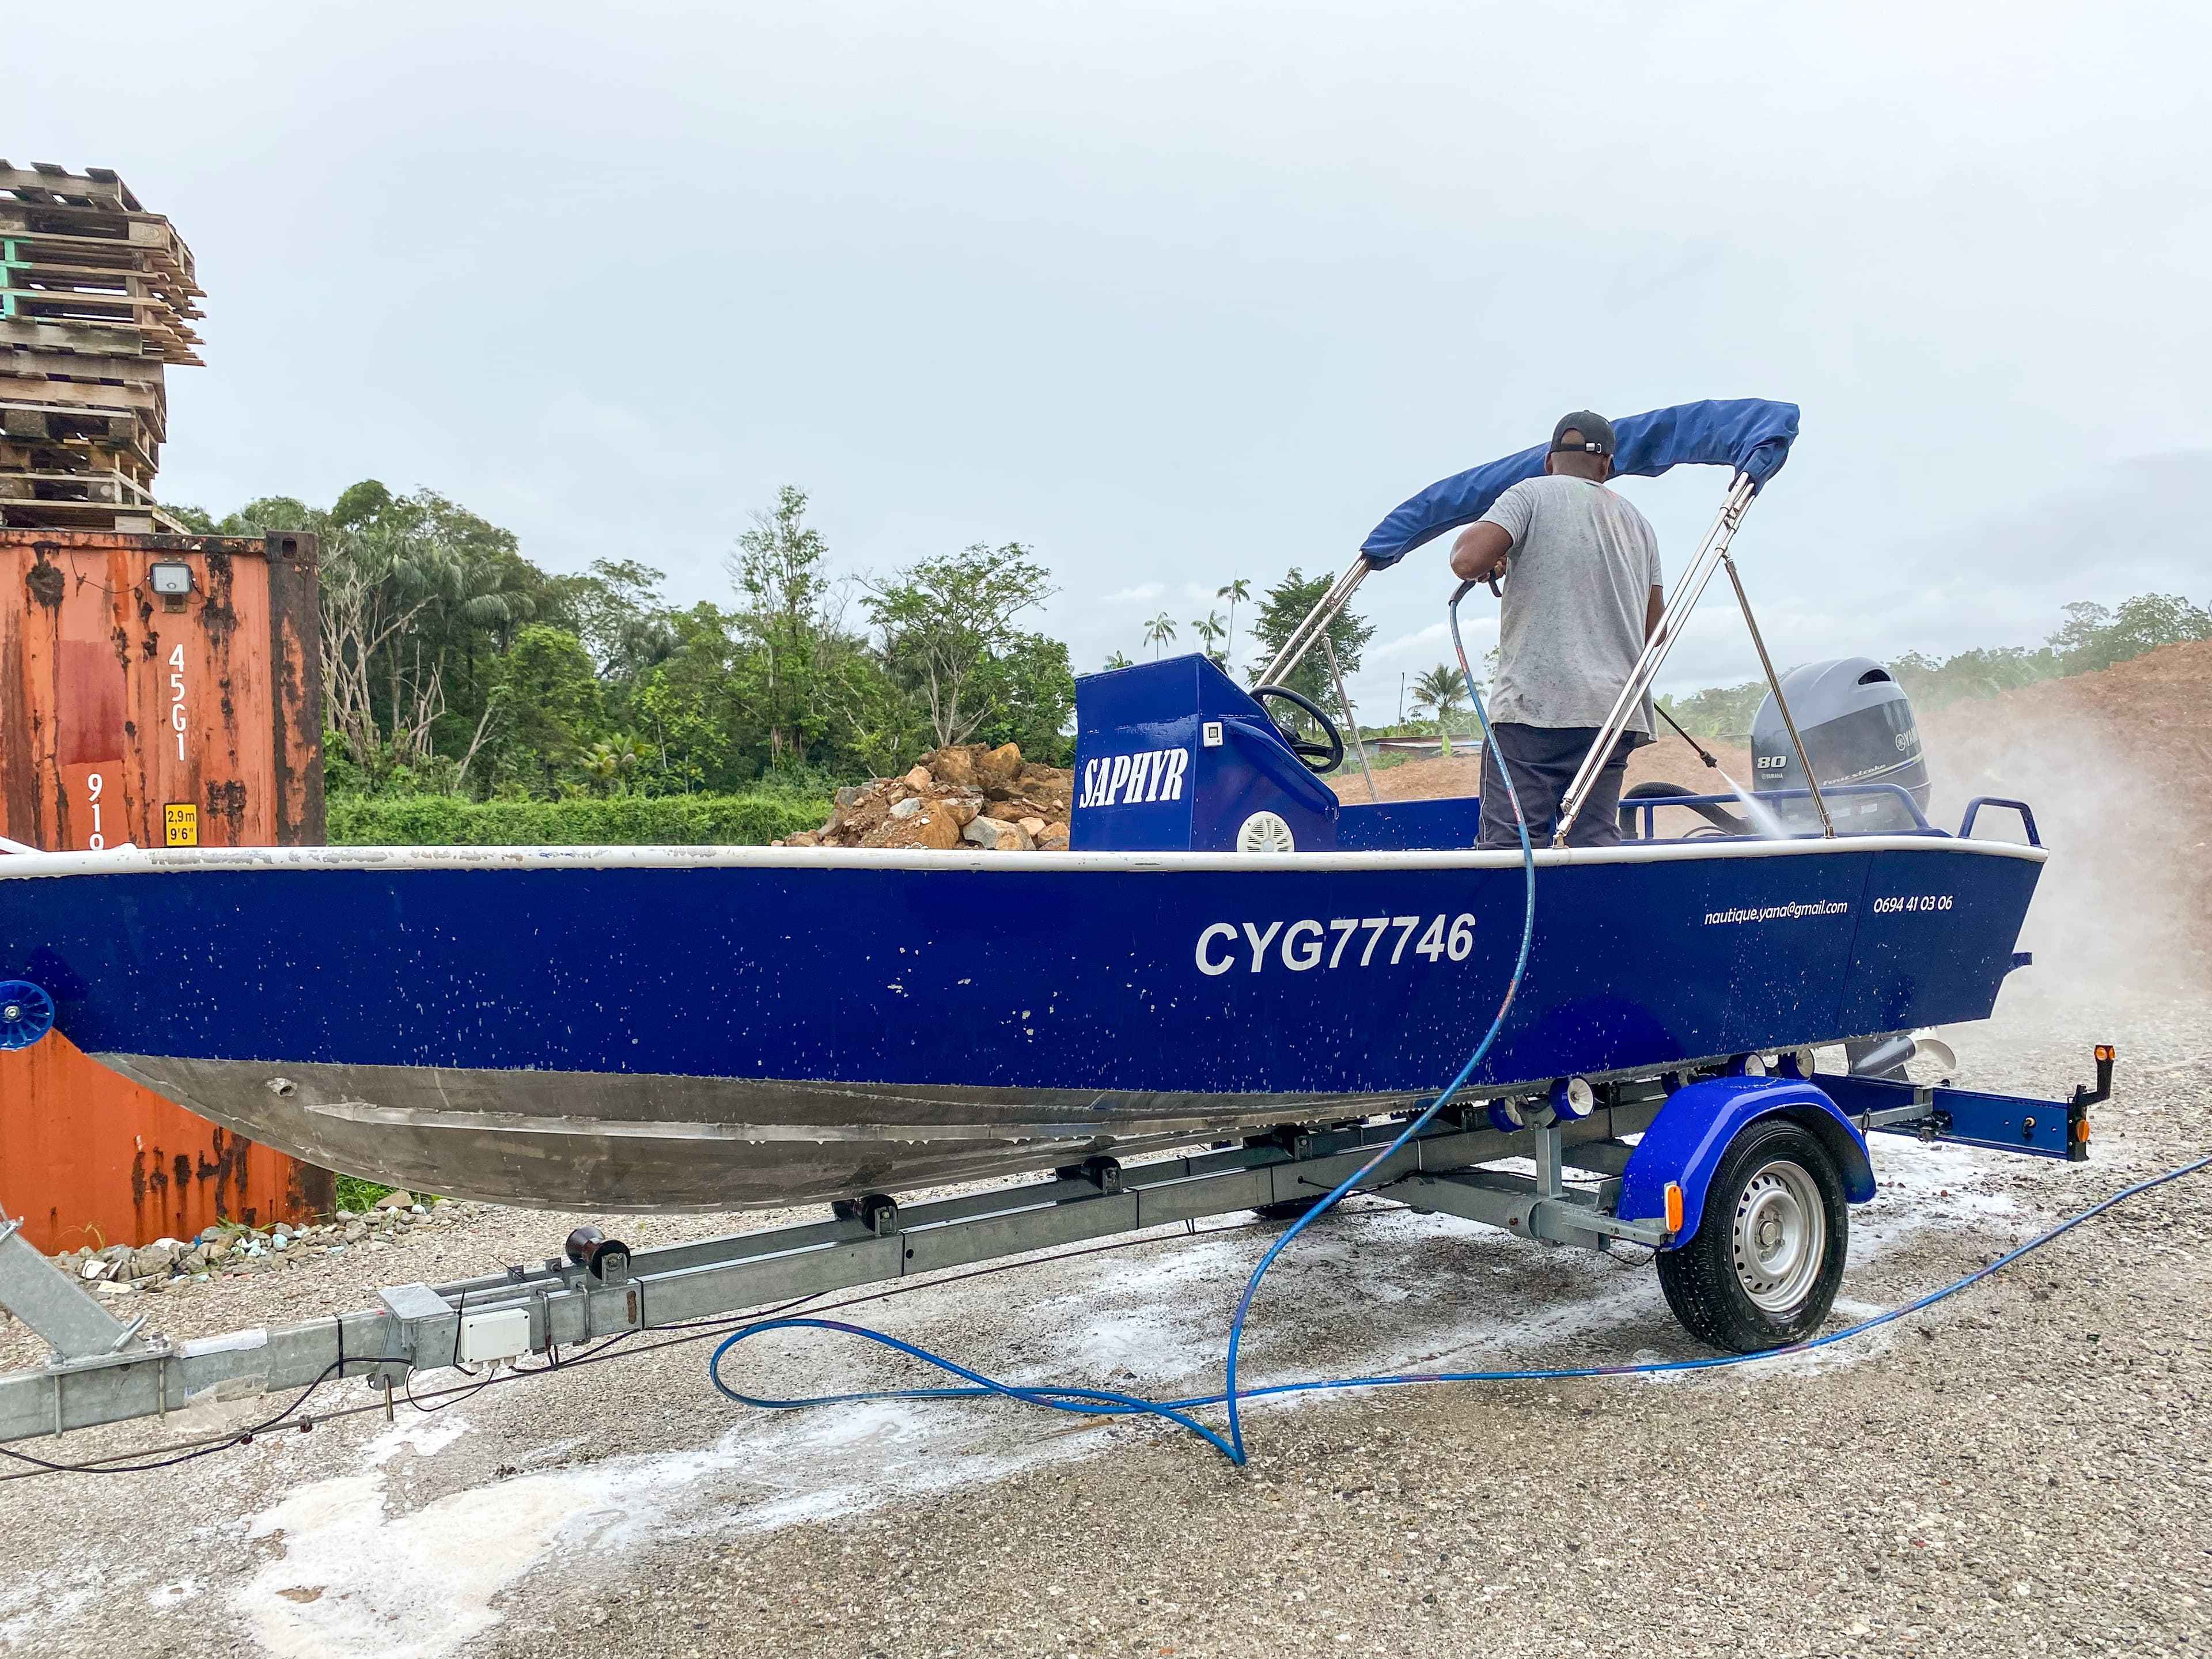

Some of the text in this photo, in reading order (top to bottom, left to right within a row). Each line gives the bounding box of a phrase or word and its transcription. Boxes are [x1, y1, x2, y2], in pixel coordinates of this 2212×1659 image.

[169, 643, 187, 761] 45G1
[1078, 747, 1188, 809] SAPHYR
[1757, 755, 1787, 769] 80
[1704, 899, 1848, 925] nautique.yana@gmail.com
[1873, 895, 1953, 913] 0694 41 03 06
[1195, 913, 1476, 976] CYG77746
